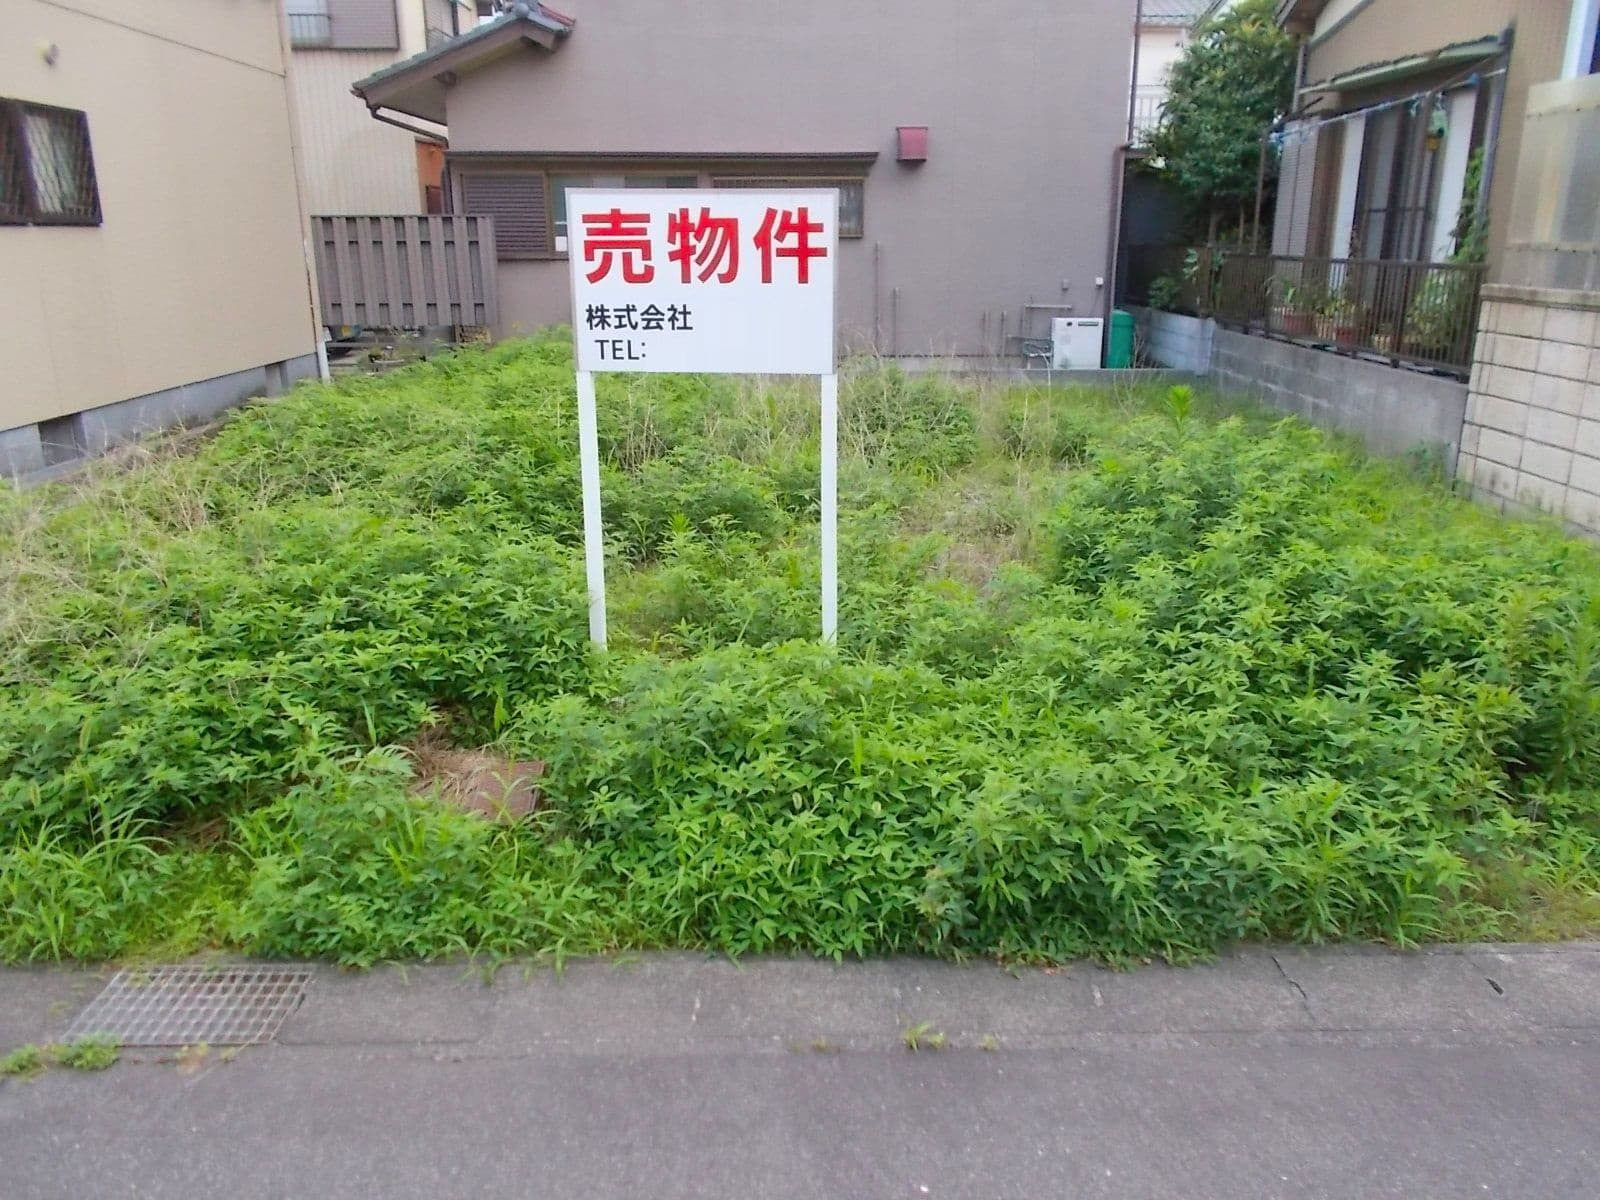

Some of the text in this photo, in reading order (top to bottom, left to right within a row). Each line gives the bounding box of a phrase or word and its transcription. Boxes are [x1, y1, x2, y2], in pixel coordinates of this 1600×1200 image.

[582, 207, 827, 285] 売物件
[585, 304, 693, 331] 株式会社
[594, 339, 647, 361] TEL:
